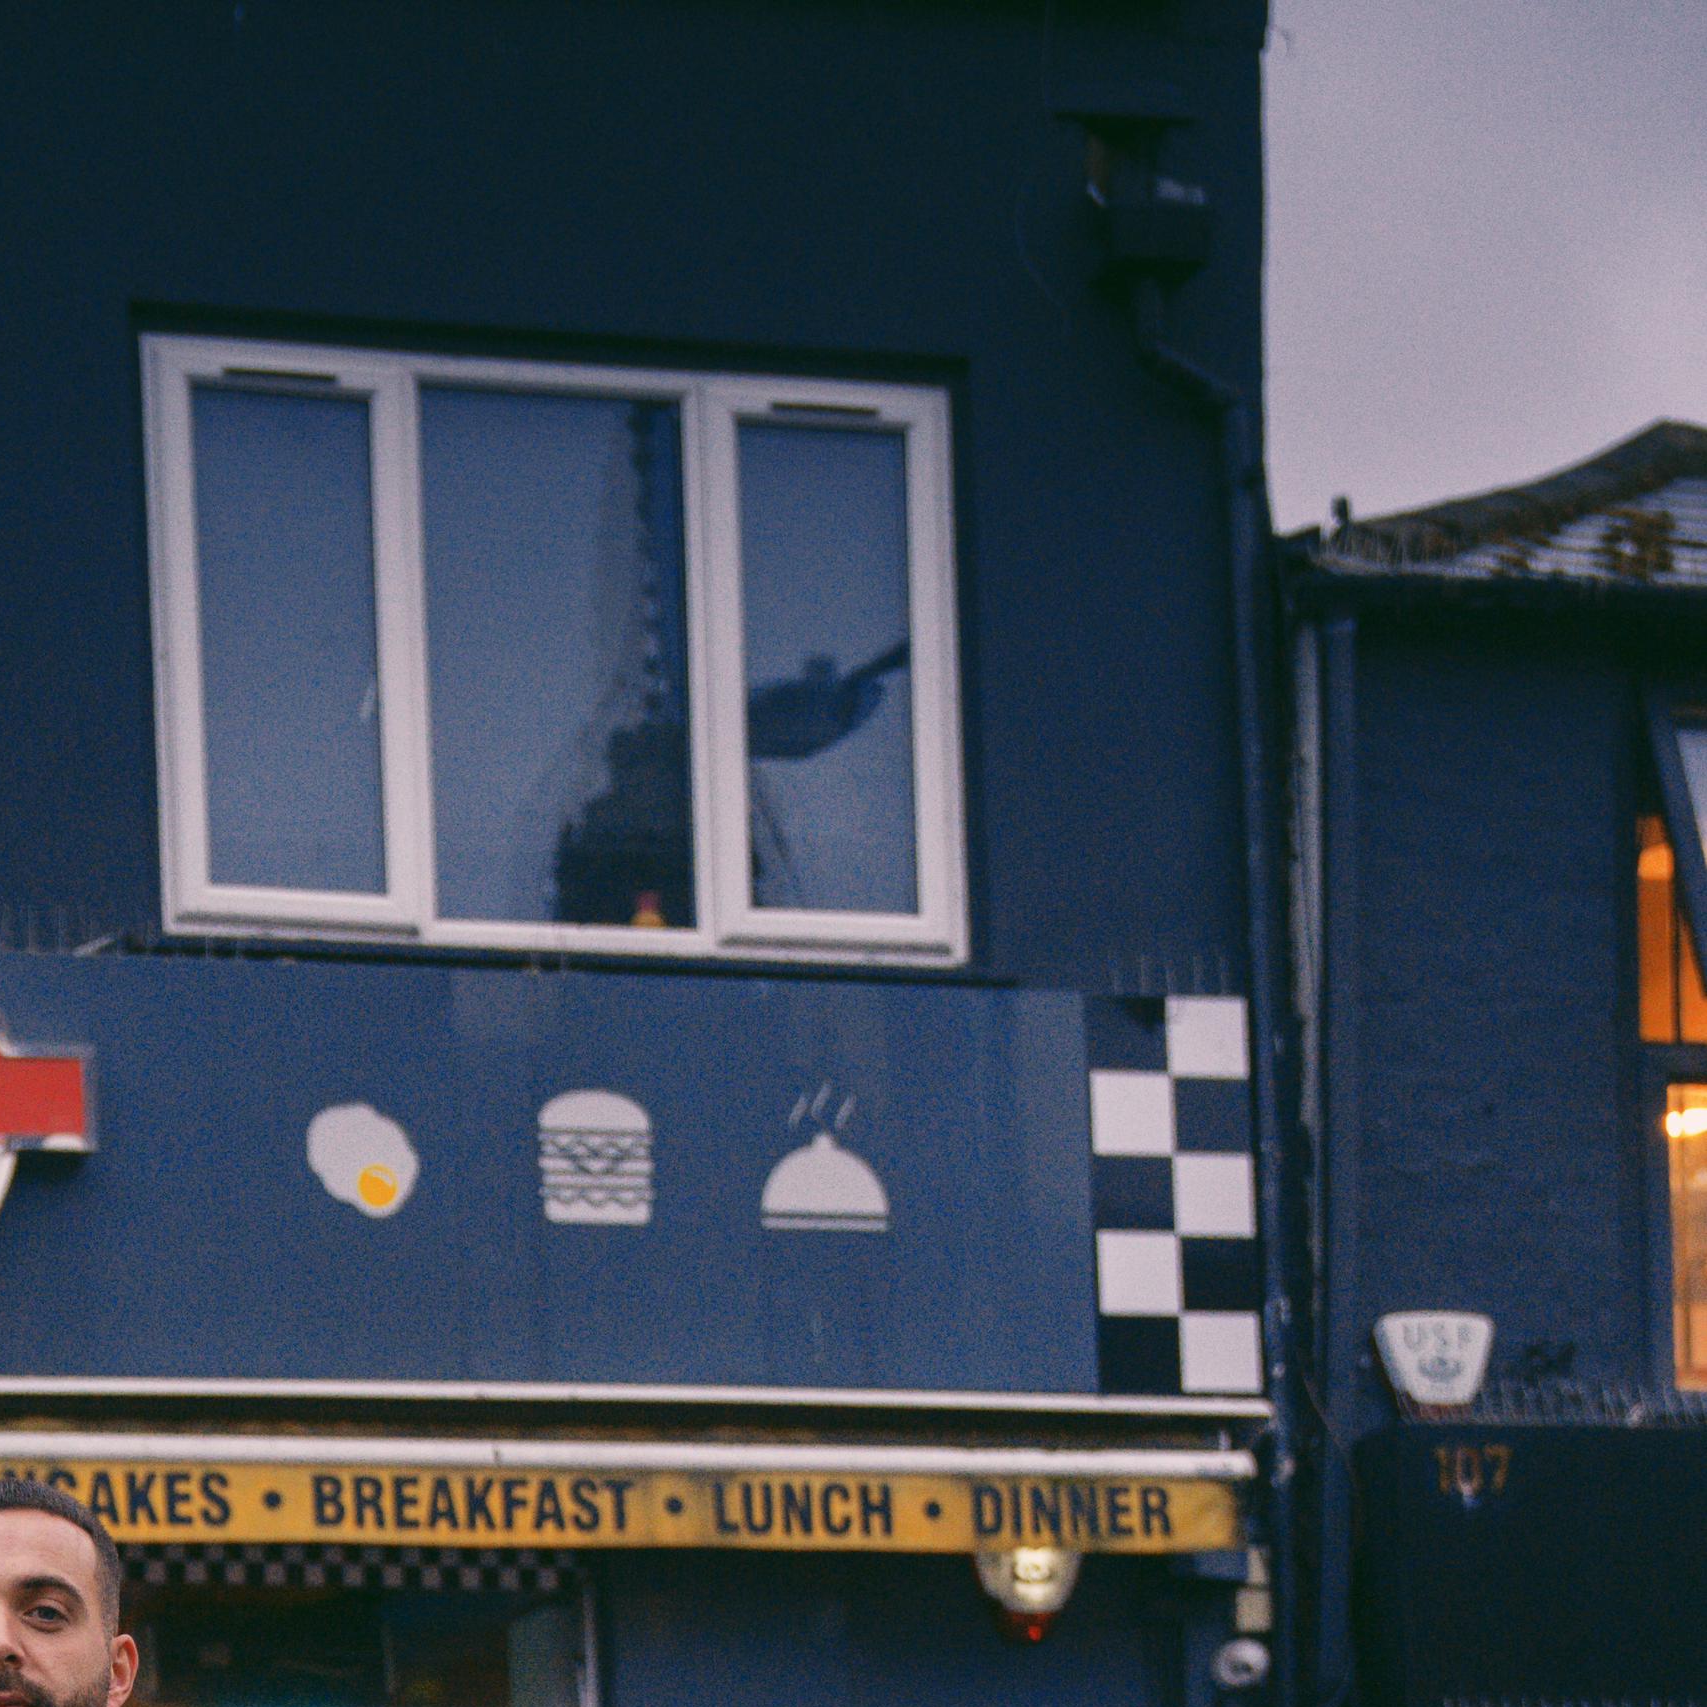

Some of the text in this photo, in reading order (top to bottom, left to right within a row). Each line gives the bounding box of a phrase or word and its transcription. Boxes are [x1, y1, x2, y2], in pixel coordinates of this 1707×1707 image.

[1434, 1444, 1513, 1496] 107
[312, 1474, 637, 1533] BREAKFAST
[711, 1480, 894, 1535] LUNCH
[972, 1484, 1176, 1538] DINNER
